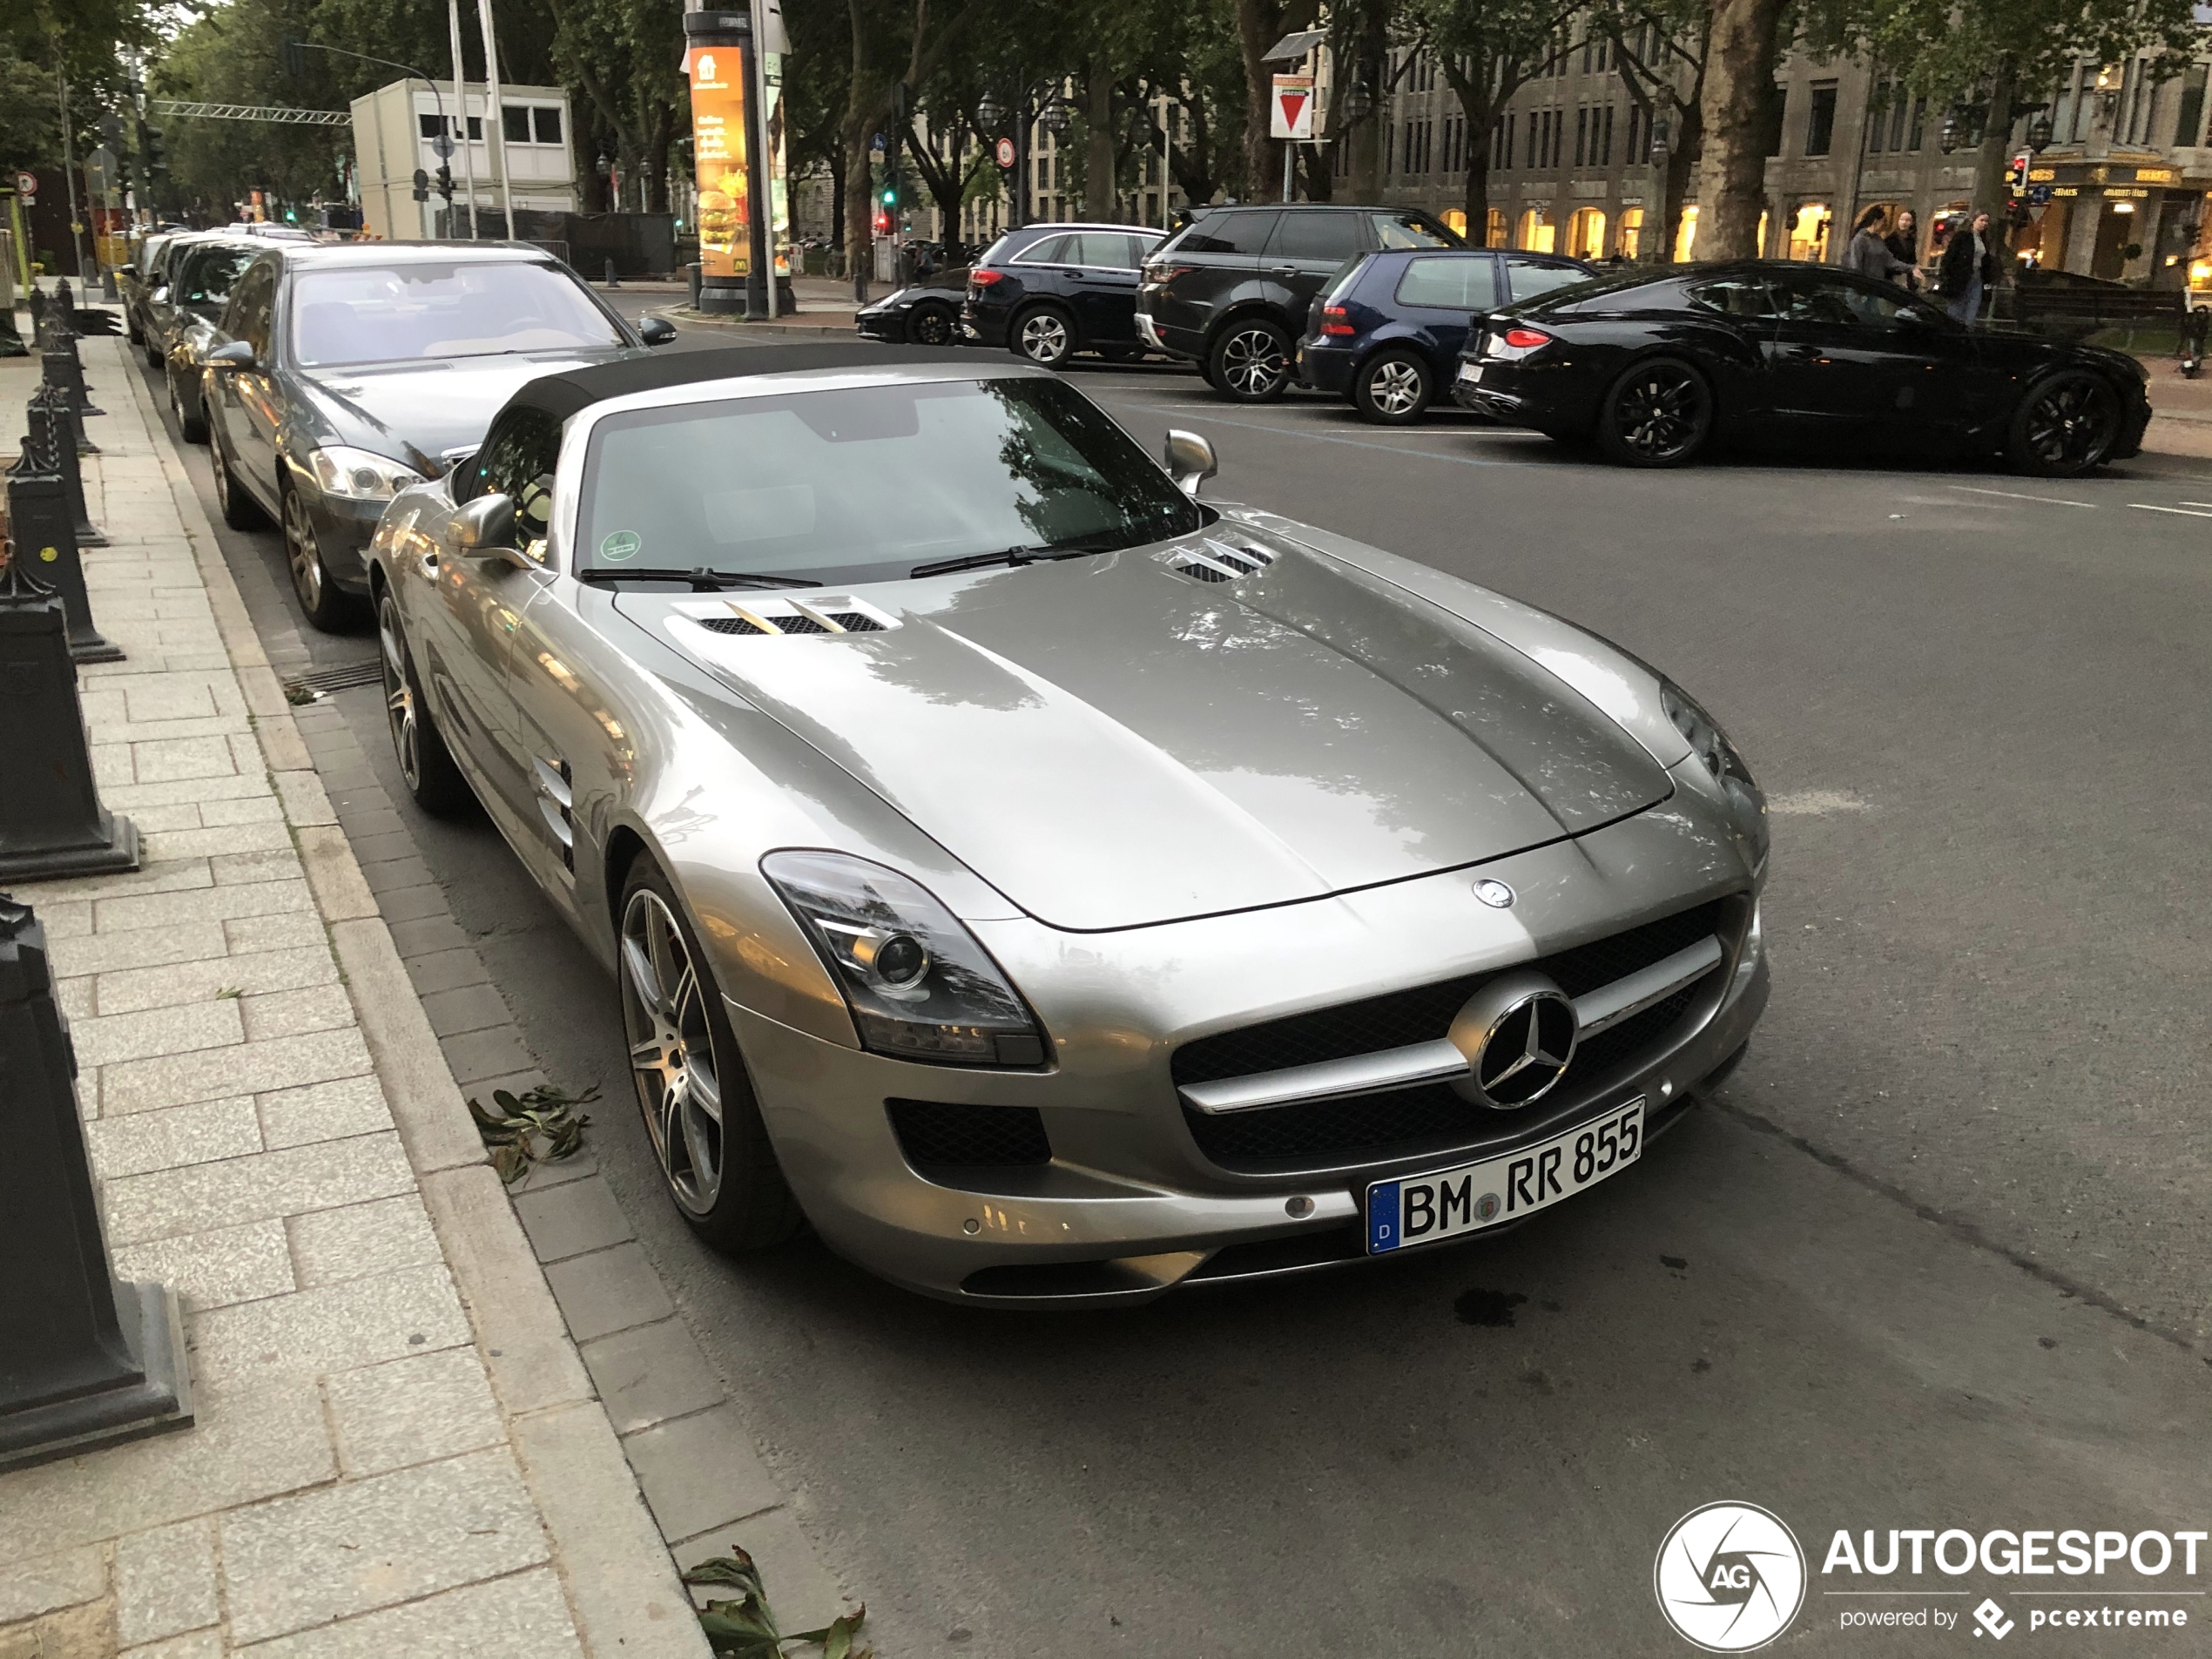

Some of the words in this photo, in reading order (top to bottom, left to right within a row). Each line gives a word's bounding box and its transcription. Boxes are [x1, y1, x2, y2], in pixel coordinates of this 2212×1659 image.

[1404, 1174, 1472, 1238] BM
[1507, 1145, 1563, 1212] RR
[1573, 1107, 1641, 1184] 855
[1379, 1224, 1391, 1240] D
